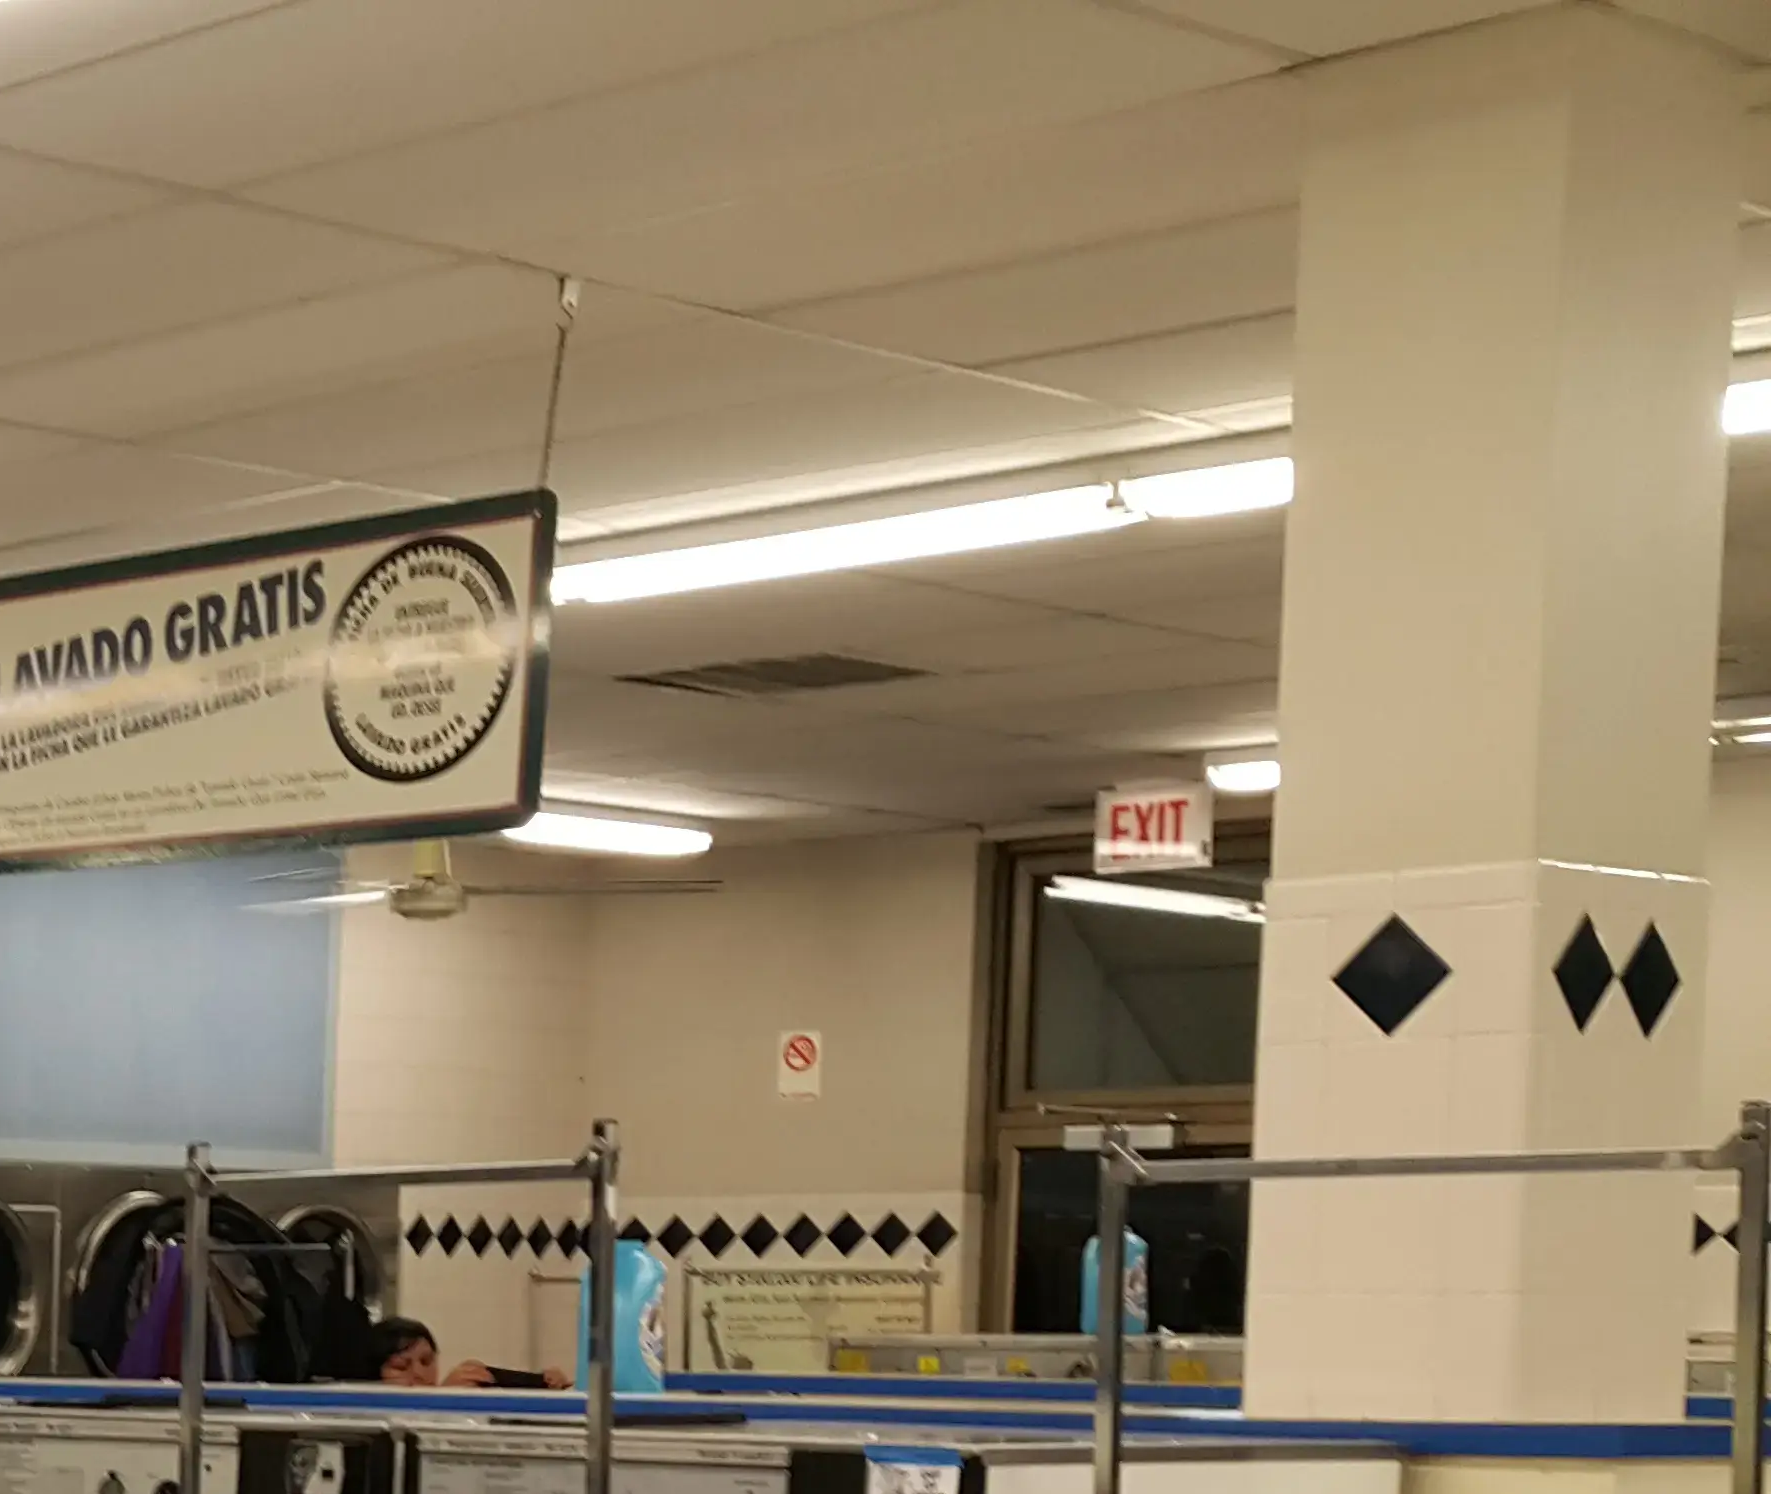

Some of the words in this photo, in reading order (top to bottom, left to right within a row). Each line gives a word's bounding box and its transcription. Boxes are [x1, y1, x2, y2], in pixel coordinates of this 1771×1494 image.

[165, 558, 327, 664] GRATIS
[11, 751, 28, 770] LA
[30, 739, 70, 767] FICHA
[72, 730, 99, 753] QUE
[101, 725, 117, 743] LE
[120, 700, 202, 739] GARANTIZA
[1110, 798, 1190, 861] EXIT
